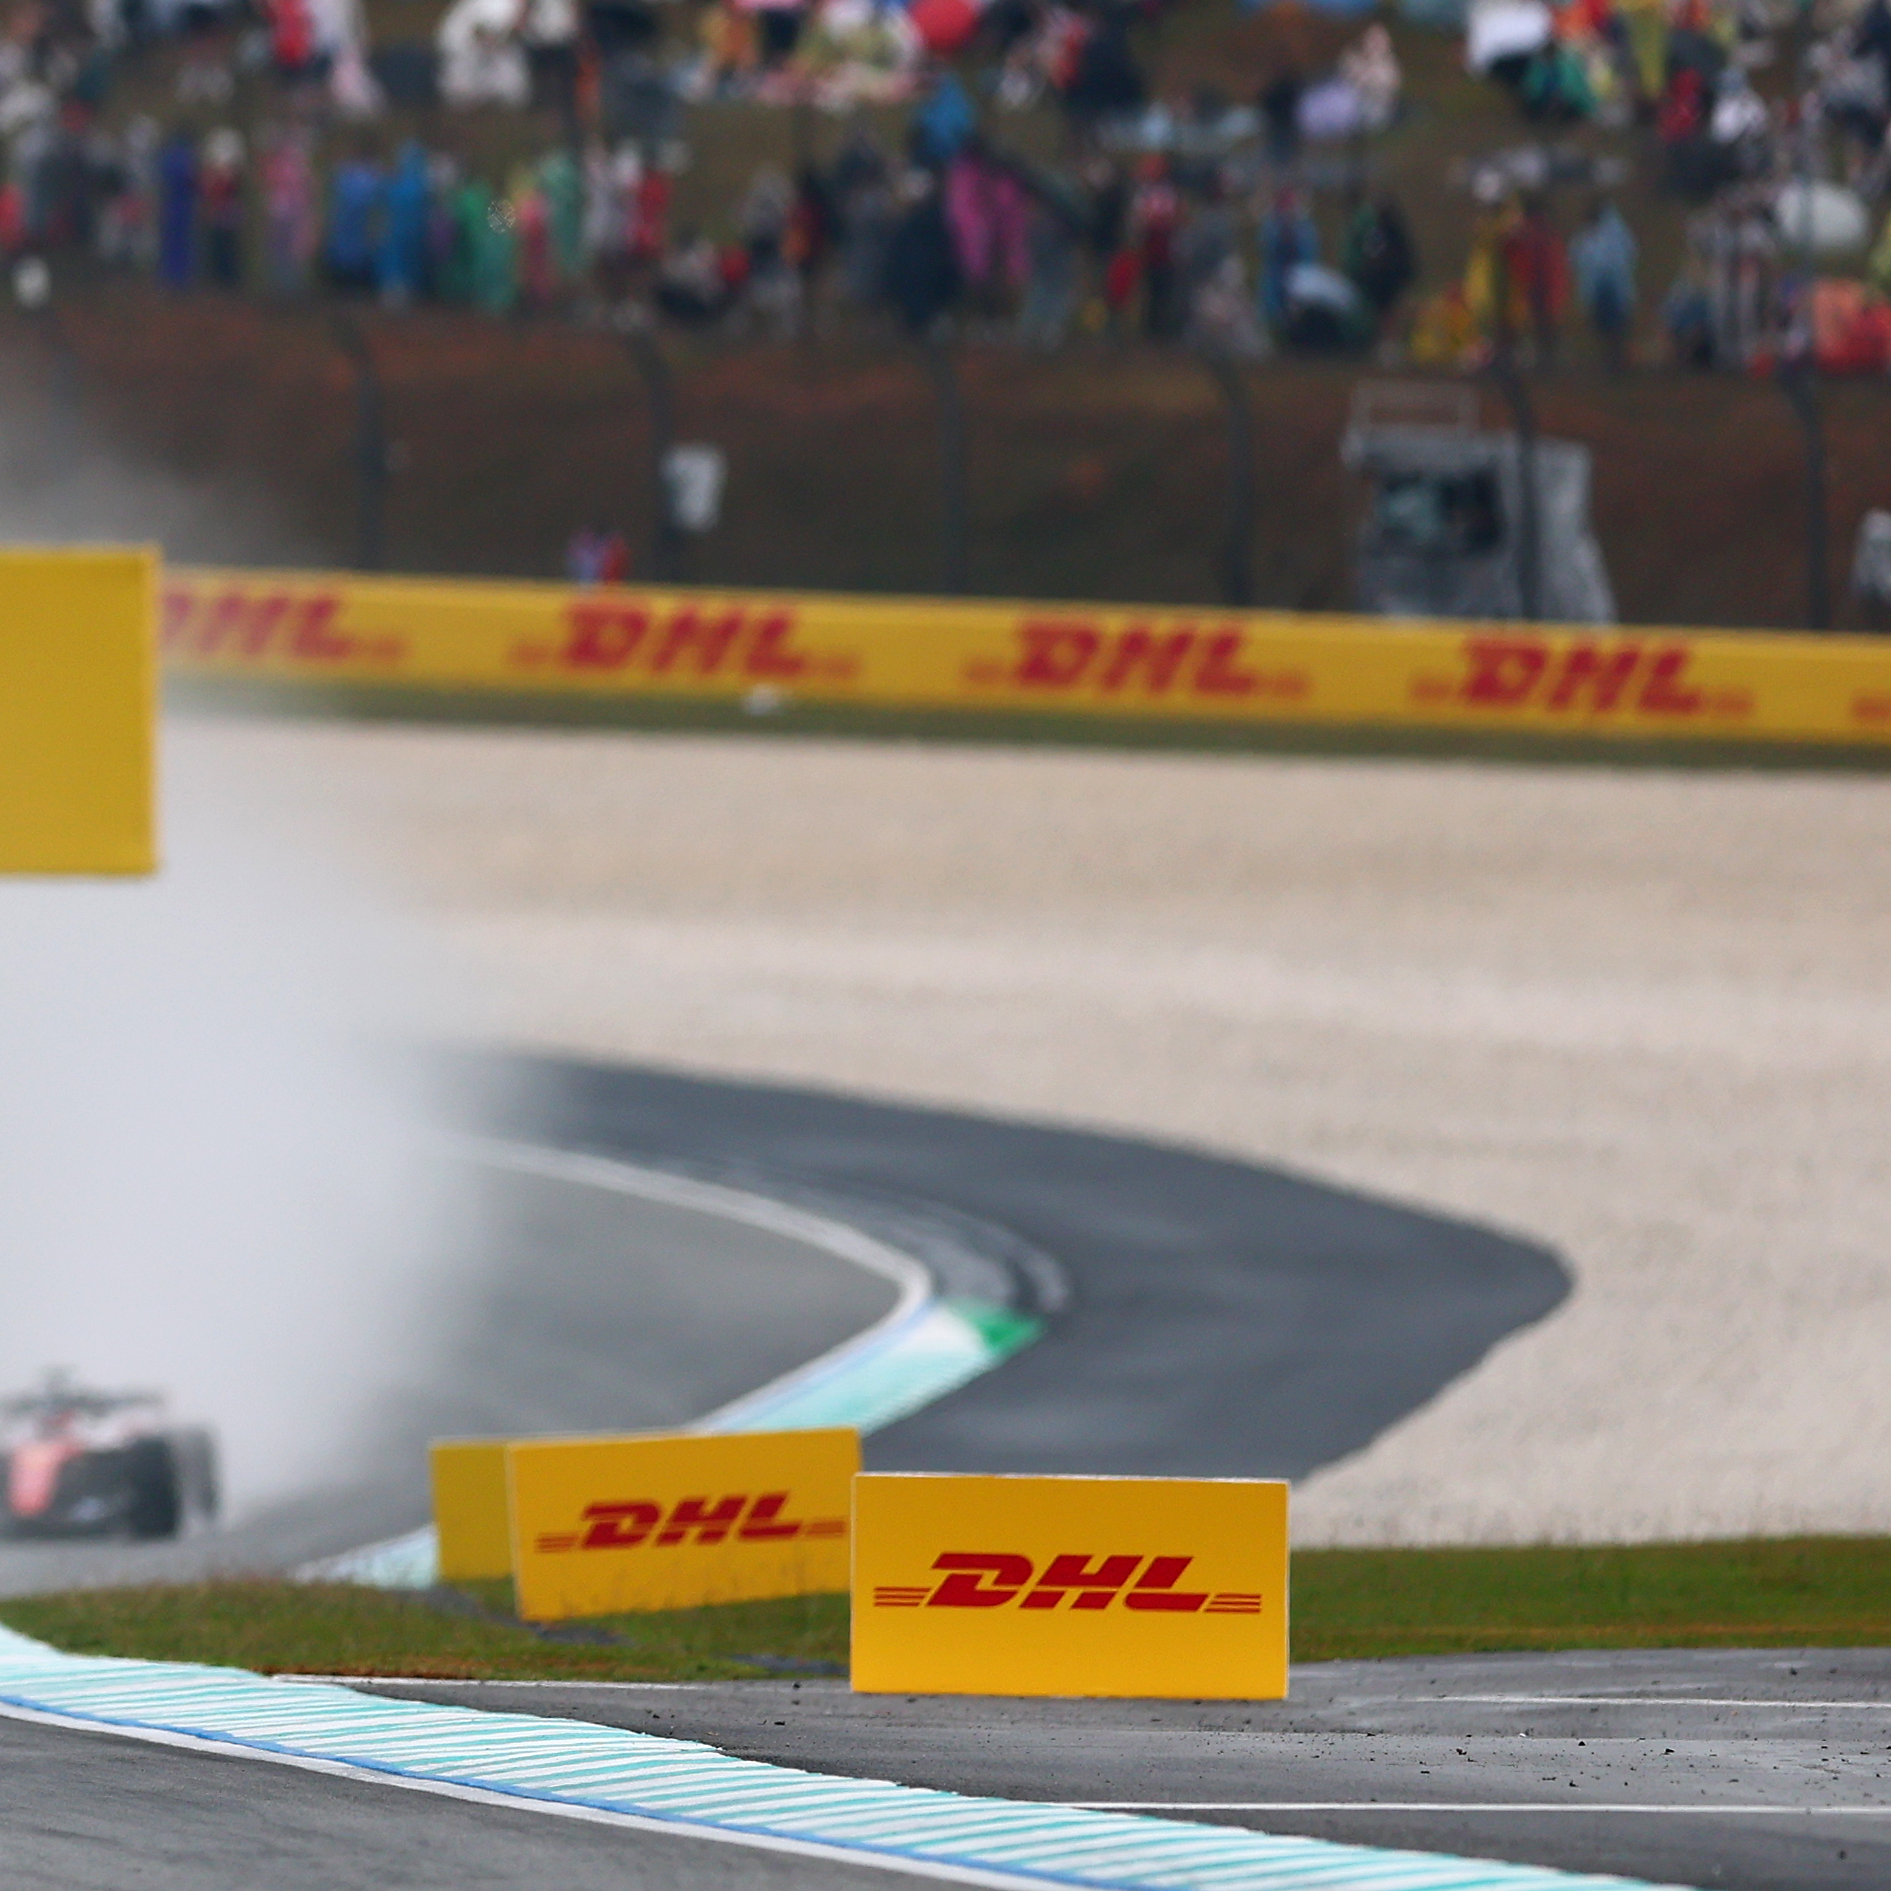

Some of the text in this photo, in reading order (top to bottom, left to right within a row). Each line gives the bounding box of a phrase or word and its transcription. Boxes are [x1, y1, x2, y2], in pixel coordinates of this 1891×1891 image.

[560, 601, 810, 677] DHL
[1014, 615, 1262, 701] DHL
[1458, 631, 1706, 715] DHL
[580, 1490, 802, 1551] DHL
[927, 1551, 1211, 1613] DHL
